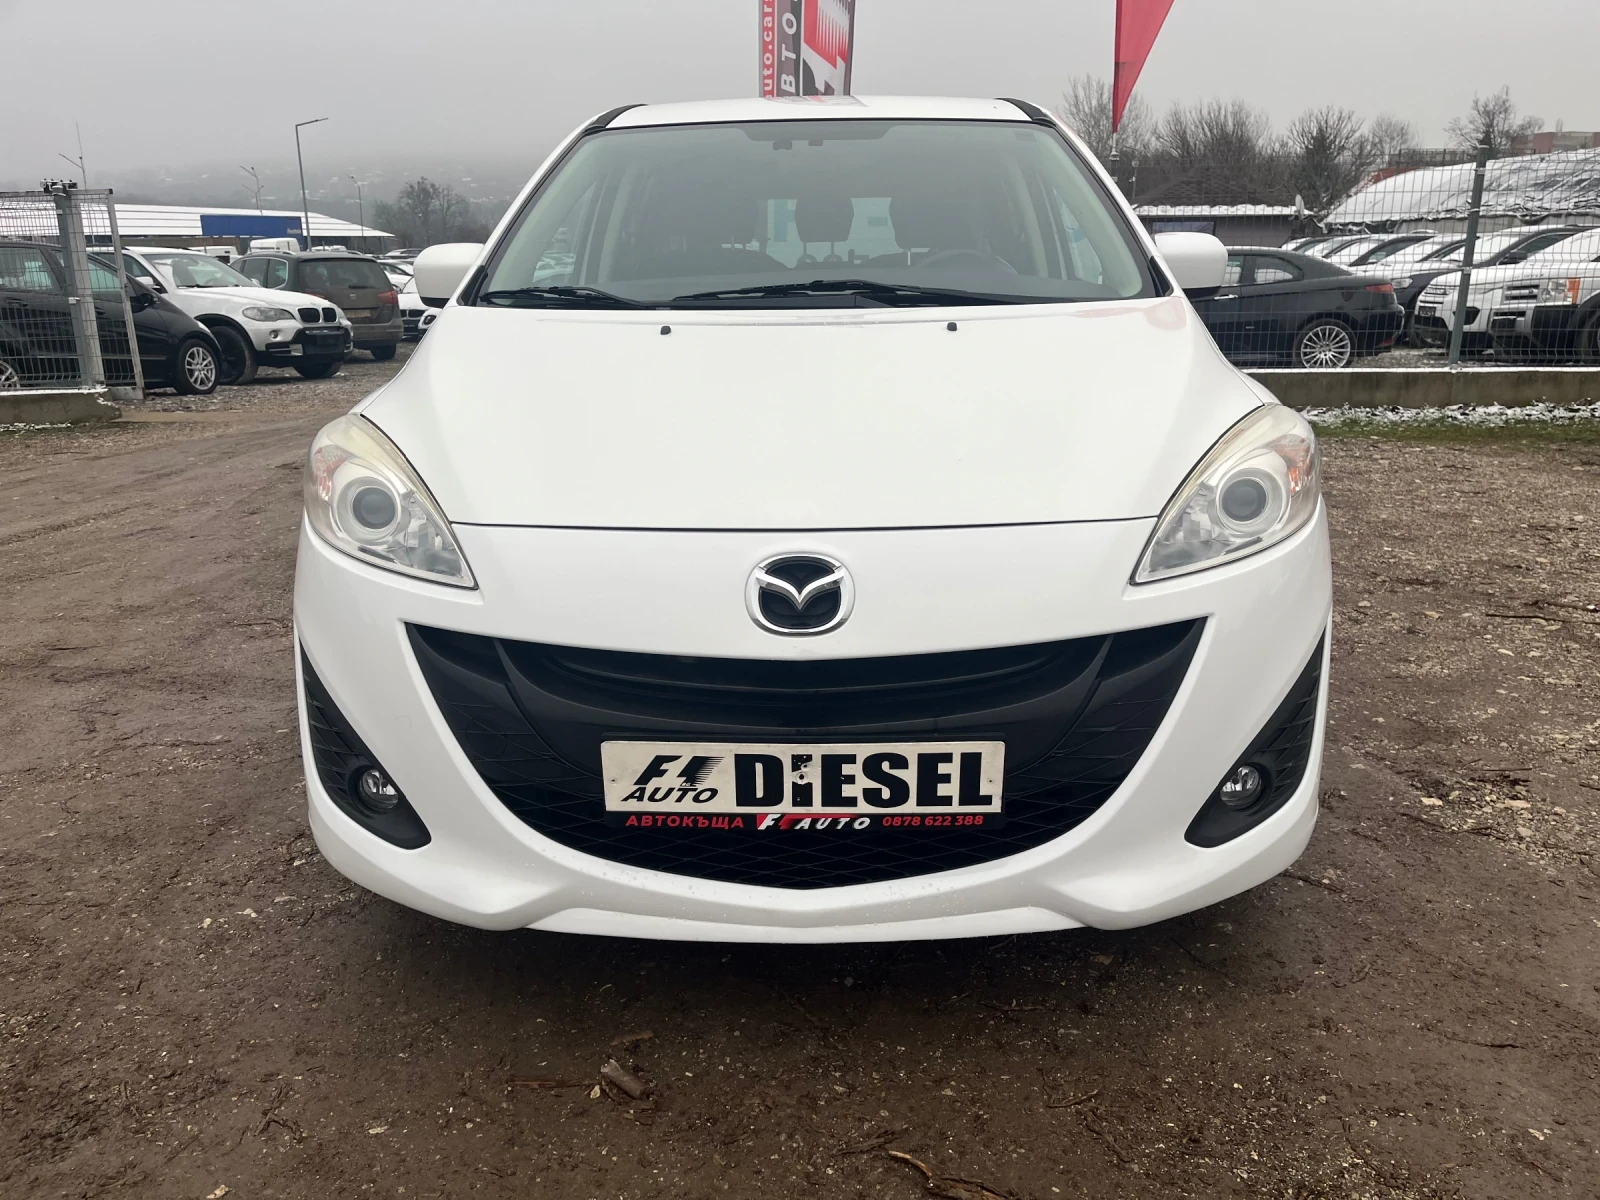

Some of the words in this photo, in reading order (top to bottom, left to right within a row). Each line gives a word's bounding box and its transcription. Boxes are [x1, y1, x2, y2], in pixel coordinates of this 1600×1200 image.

[763, 0, 773, 97] uto.car
[781, 0, 798, 94] ВТО
[633, 755, 725, 787] F1
[621, 787, 708, 803] AUTO
[626, 815, 744, 830] АВТОКЪЩА
[794, 817, 871, 830] AUTO
[882, 816, 921, 827] 0878
[924, 815, 952, 826] 622
[954, 815, 984, 826] 388
